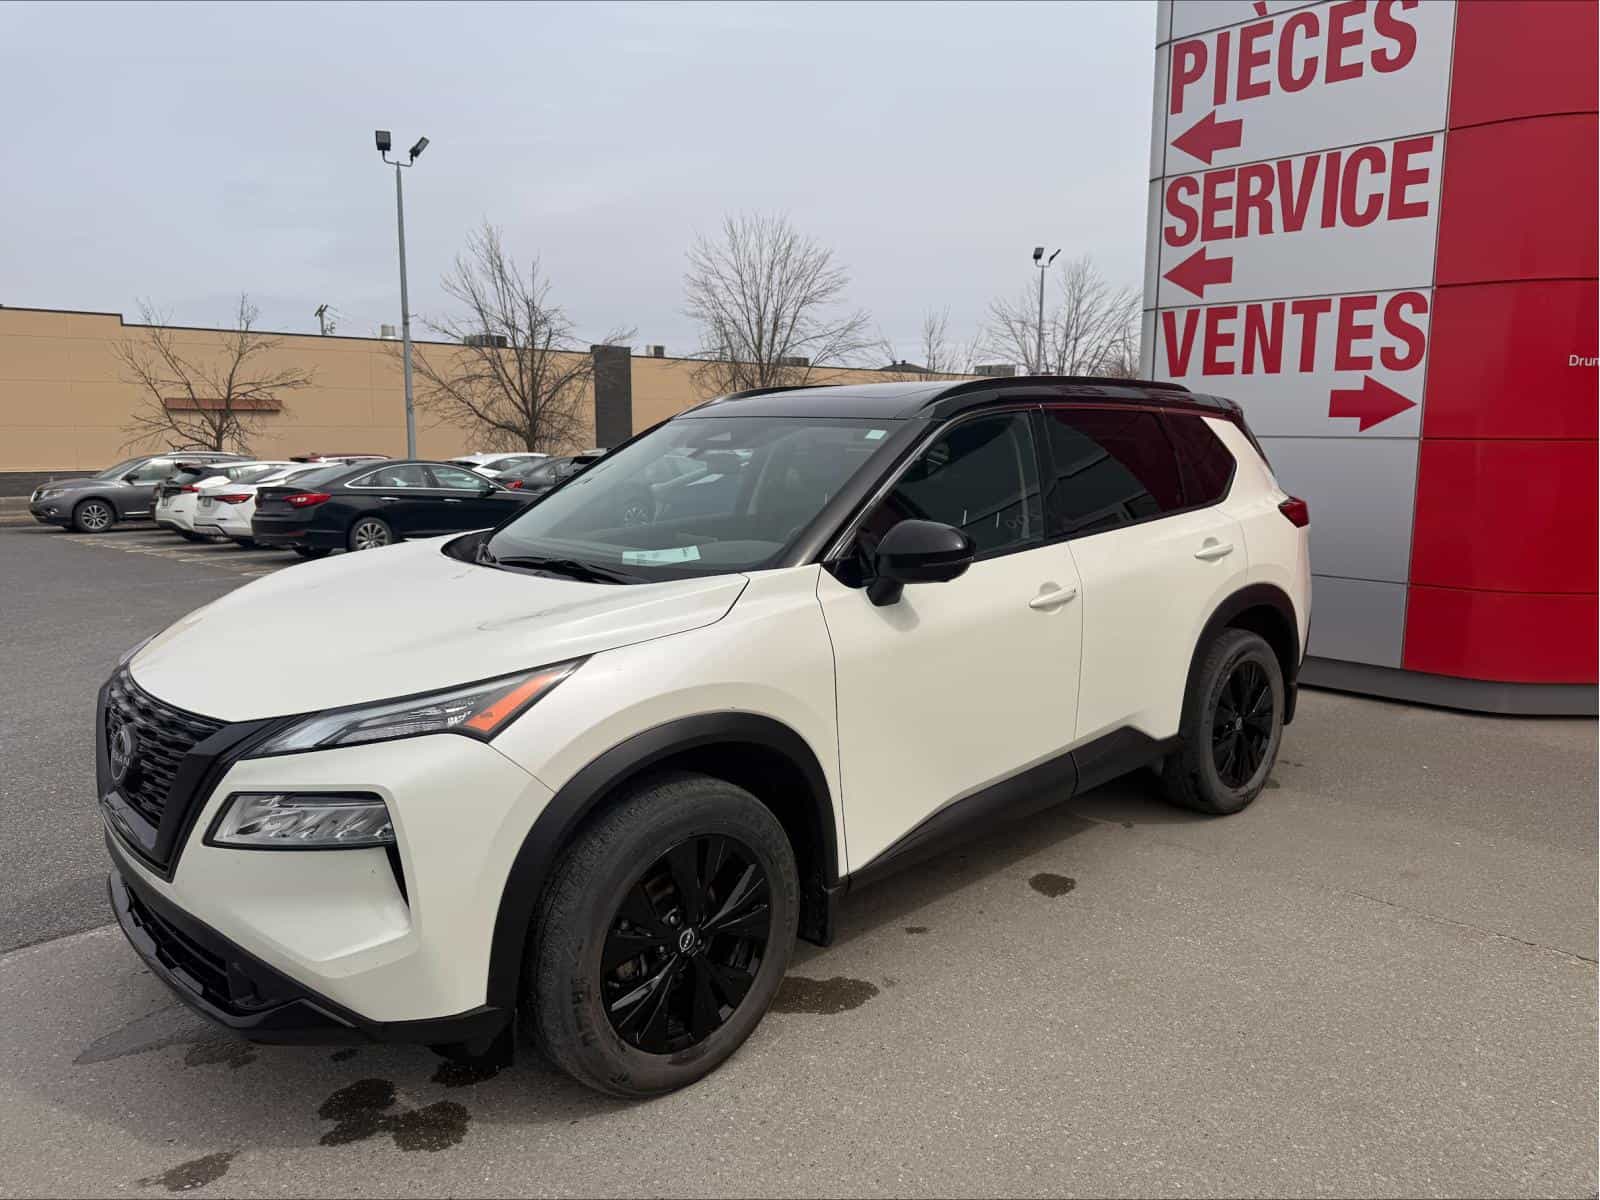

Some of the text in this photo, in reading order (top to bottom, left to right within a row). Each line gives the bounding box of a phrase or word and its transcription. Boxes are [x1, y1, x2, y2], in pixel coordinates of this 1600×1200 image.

[1169, 0, 1419, 115] PIÈCES
[1163, 136, 1434, 247] SERVICE
[1162, 292, 1429, 378] VENTES
